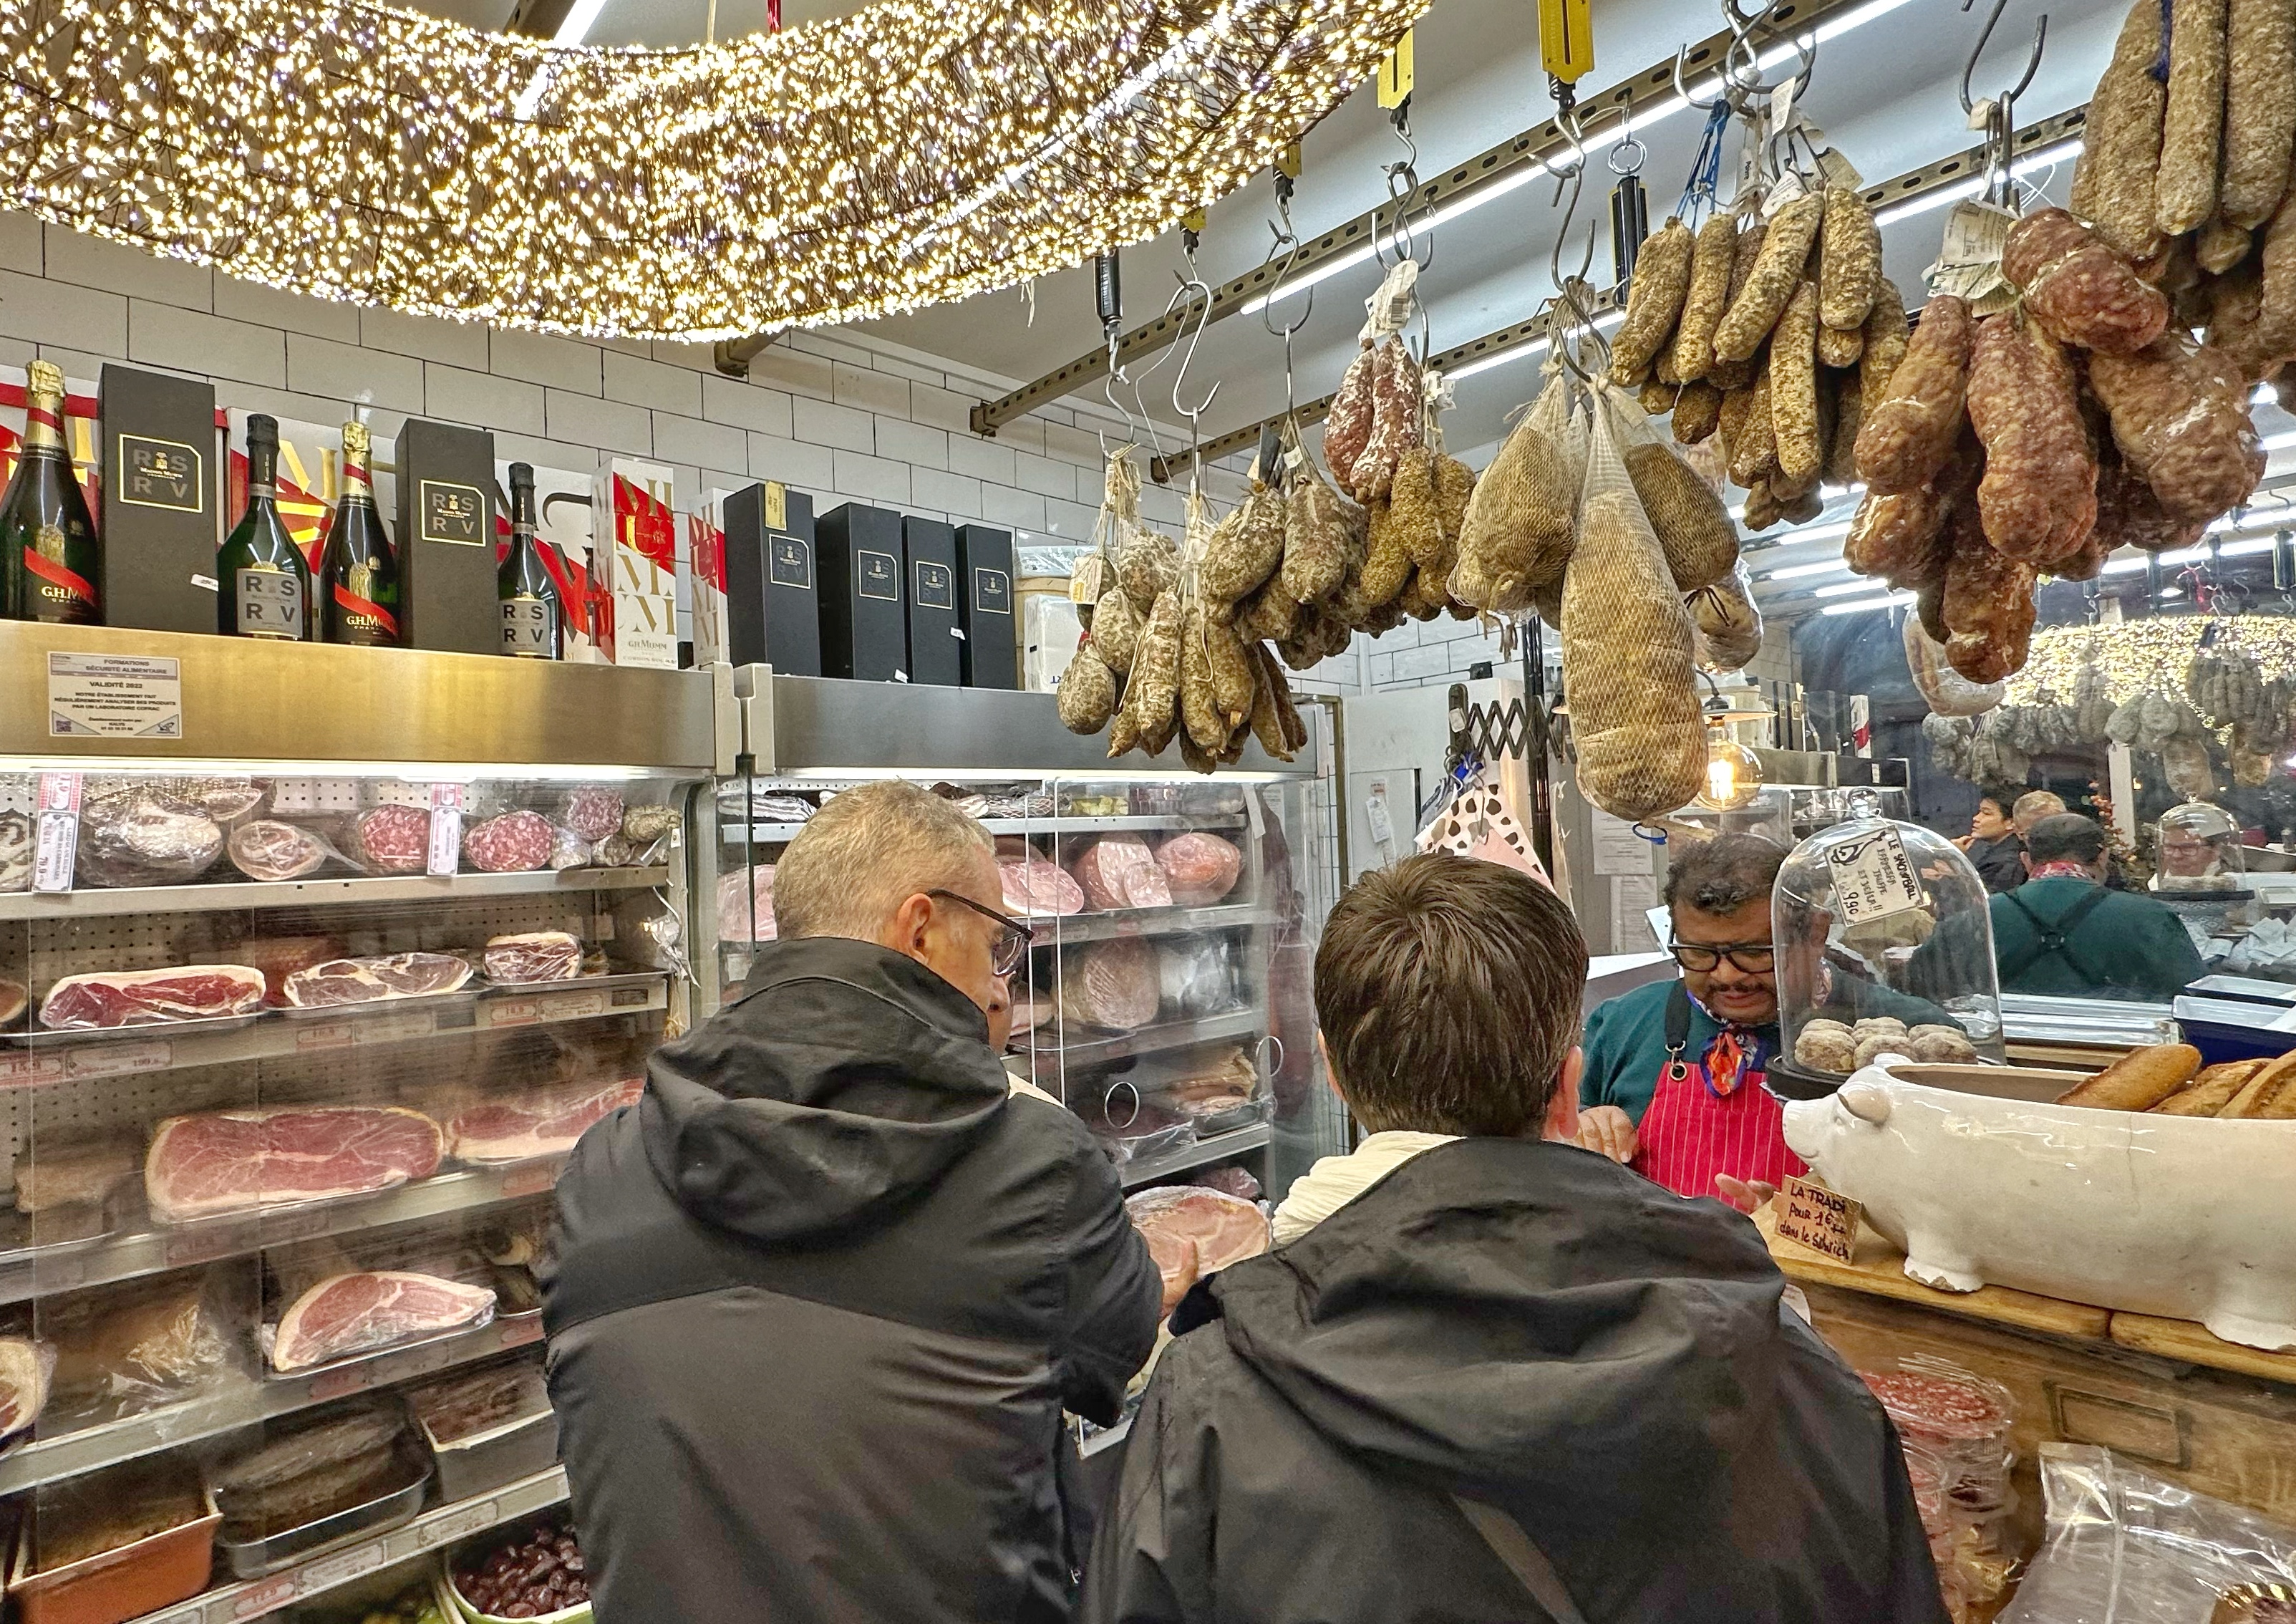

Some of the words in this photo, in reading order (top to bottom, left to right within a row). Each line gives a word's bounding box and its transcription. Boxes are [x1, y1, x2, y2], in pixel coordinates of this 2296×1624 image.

[133, 448, 152, 467] R
[170, 455, 188, 472] S
[134, 475, 152, 495] R
[169, 480, 188, 499] V
[432, 493, 446, 508] R
[461, 497, 474, 511] S
[432, 516, 447, 532] R
[461, 520, 475, 535] V
[246, 576, 262, 592] R
[281, 580, 295, 596] S
[246, 602, 263, 619] R
[281, 606, 295, 622] V
[503, 605, 515, 619] R
[531, 605, 543, 620] S
[504, 629, 516, 642] R
[531, 629, 543, 642] V
[1888, 838, 1899, 851] LE
[1894, 853, 1917, 900] SNOWBALL
[1791, 1181, 1804, 1199] LA
